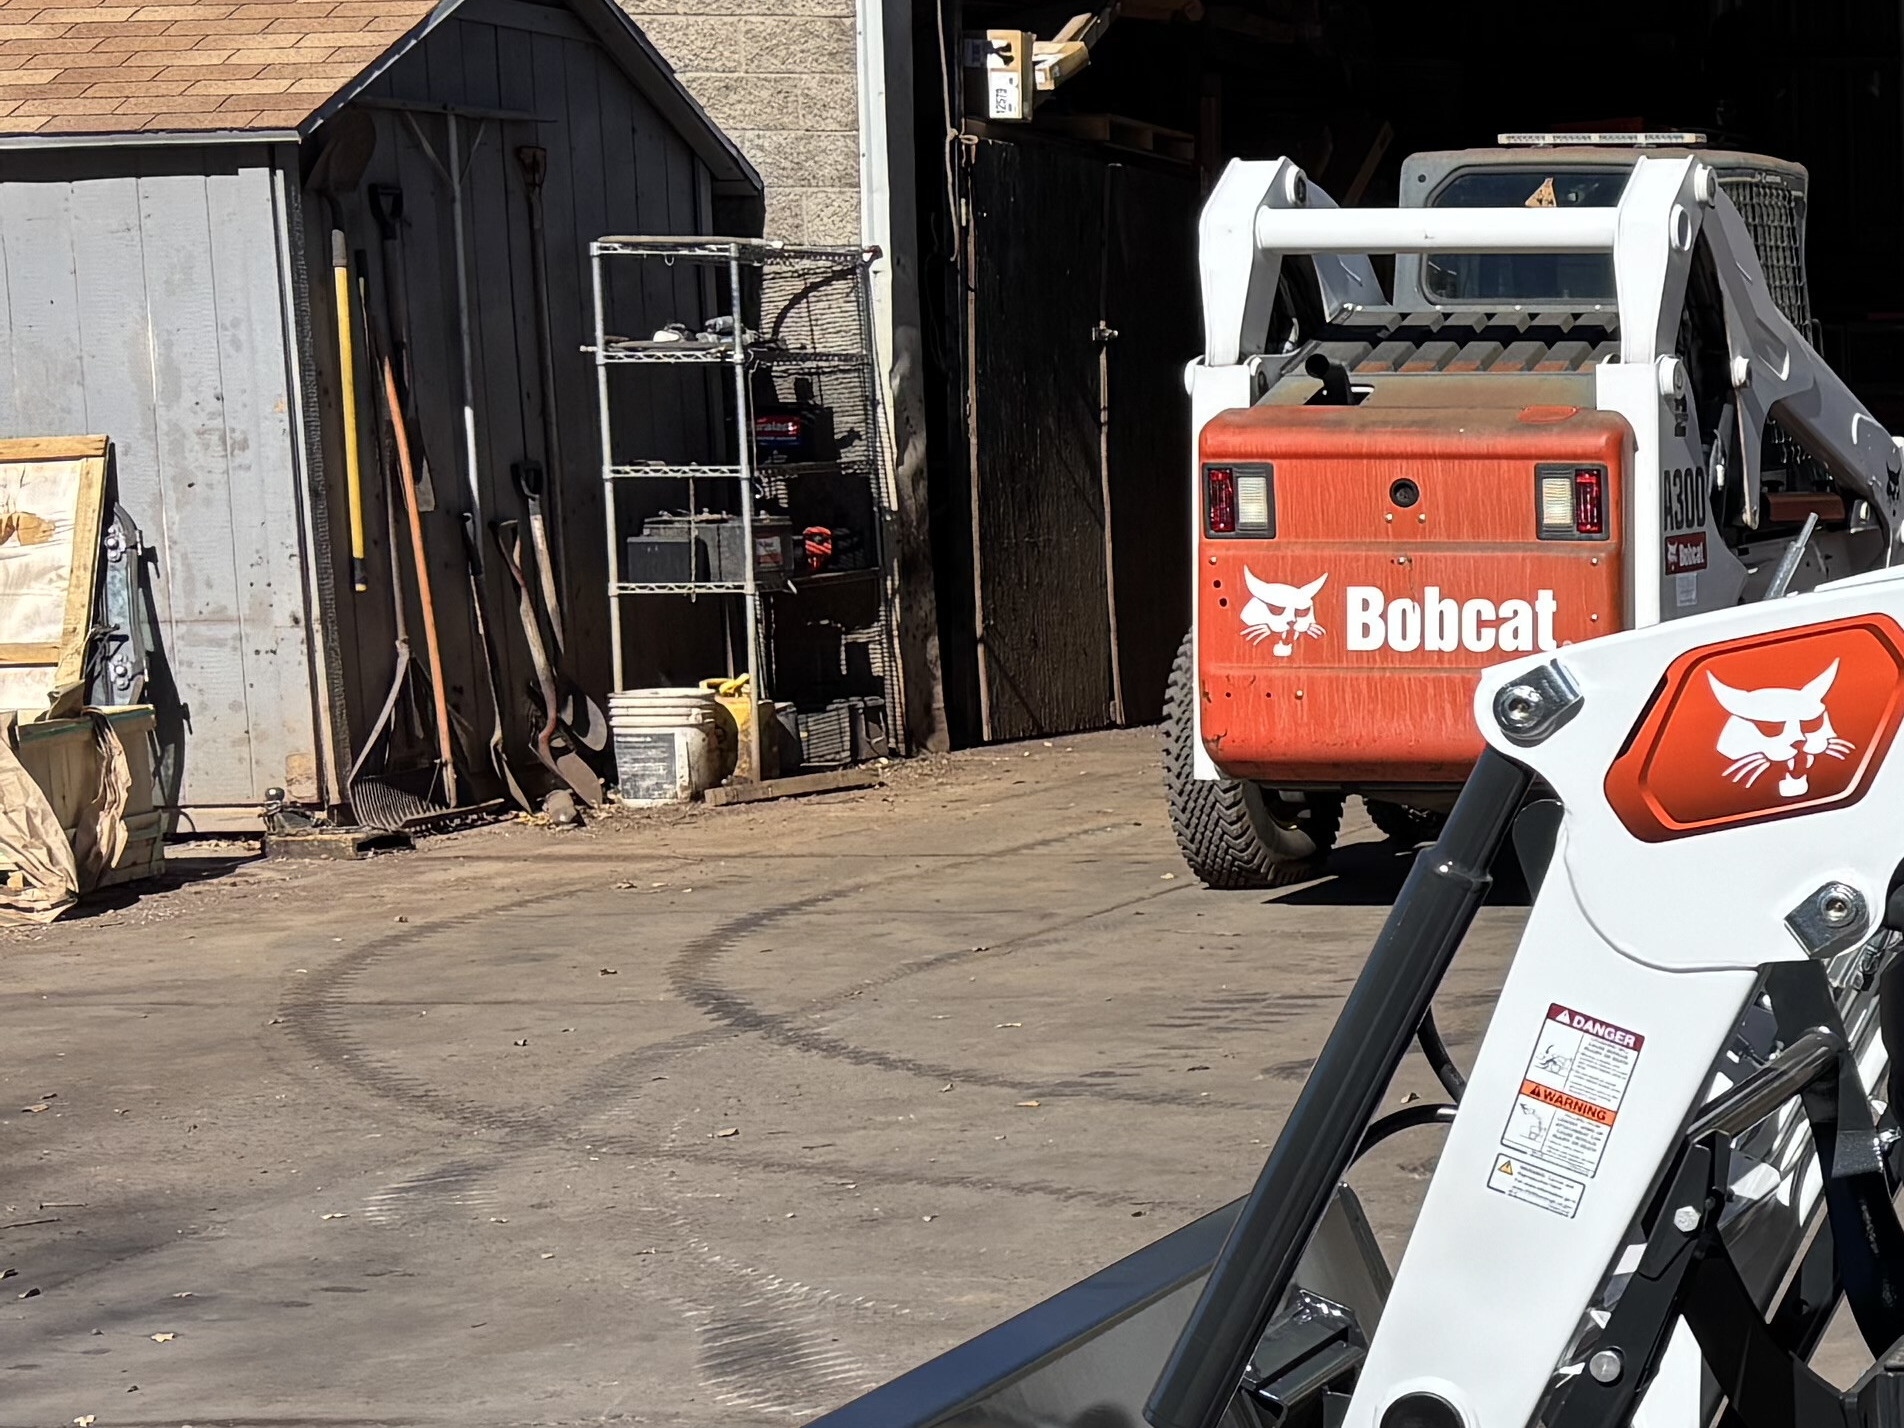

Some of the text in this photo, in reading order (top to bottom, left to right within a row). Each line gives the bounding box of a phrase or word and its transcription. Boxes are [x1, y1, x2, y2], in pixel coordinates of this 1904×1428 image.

[1663, 465, 1707, 533] A300
[1346, 585, 1558, 653] Bobcat
[1572, 1014, 1636, 1048] DANGER
[1542, 1089, 1607, 1121] WARNING
